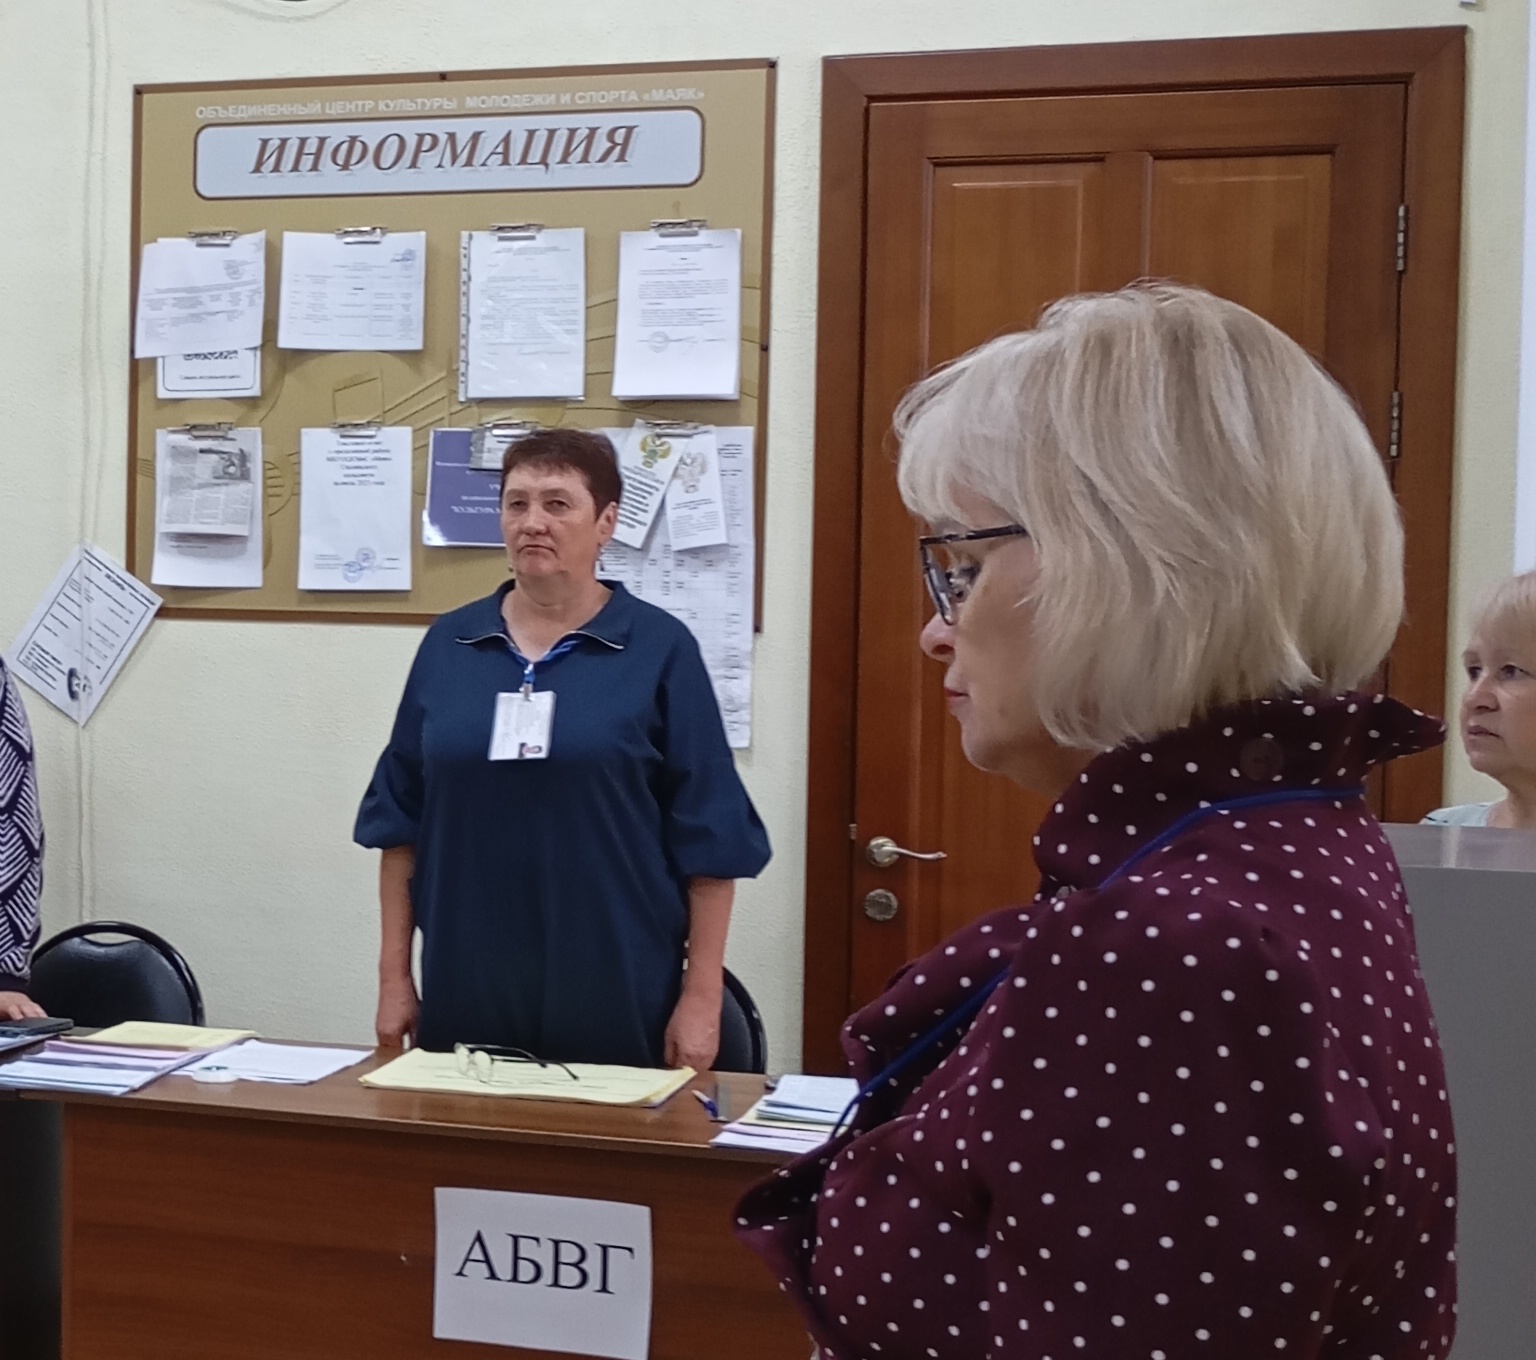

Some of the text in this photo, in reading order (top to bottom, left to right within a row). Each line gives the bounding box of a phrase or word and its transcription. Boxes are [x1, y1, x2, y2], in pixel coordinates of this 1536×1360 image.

[195, 87, 705, 119] ОБЪЕДИНЕННЫЙ ЦЕНТР КУЛЬТУРЫ МОЛОДЕЖИ И СПОРТА «МАЯК»
[249, 124, 640, 175] ИНФОРМАЦИЯ
[453, 1229, 636, 1295] АБВГ
